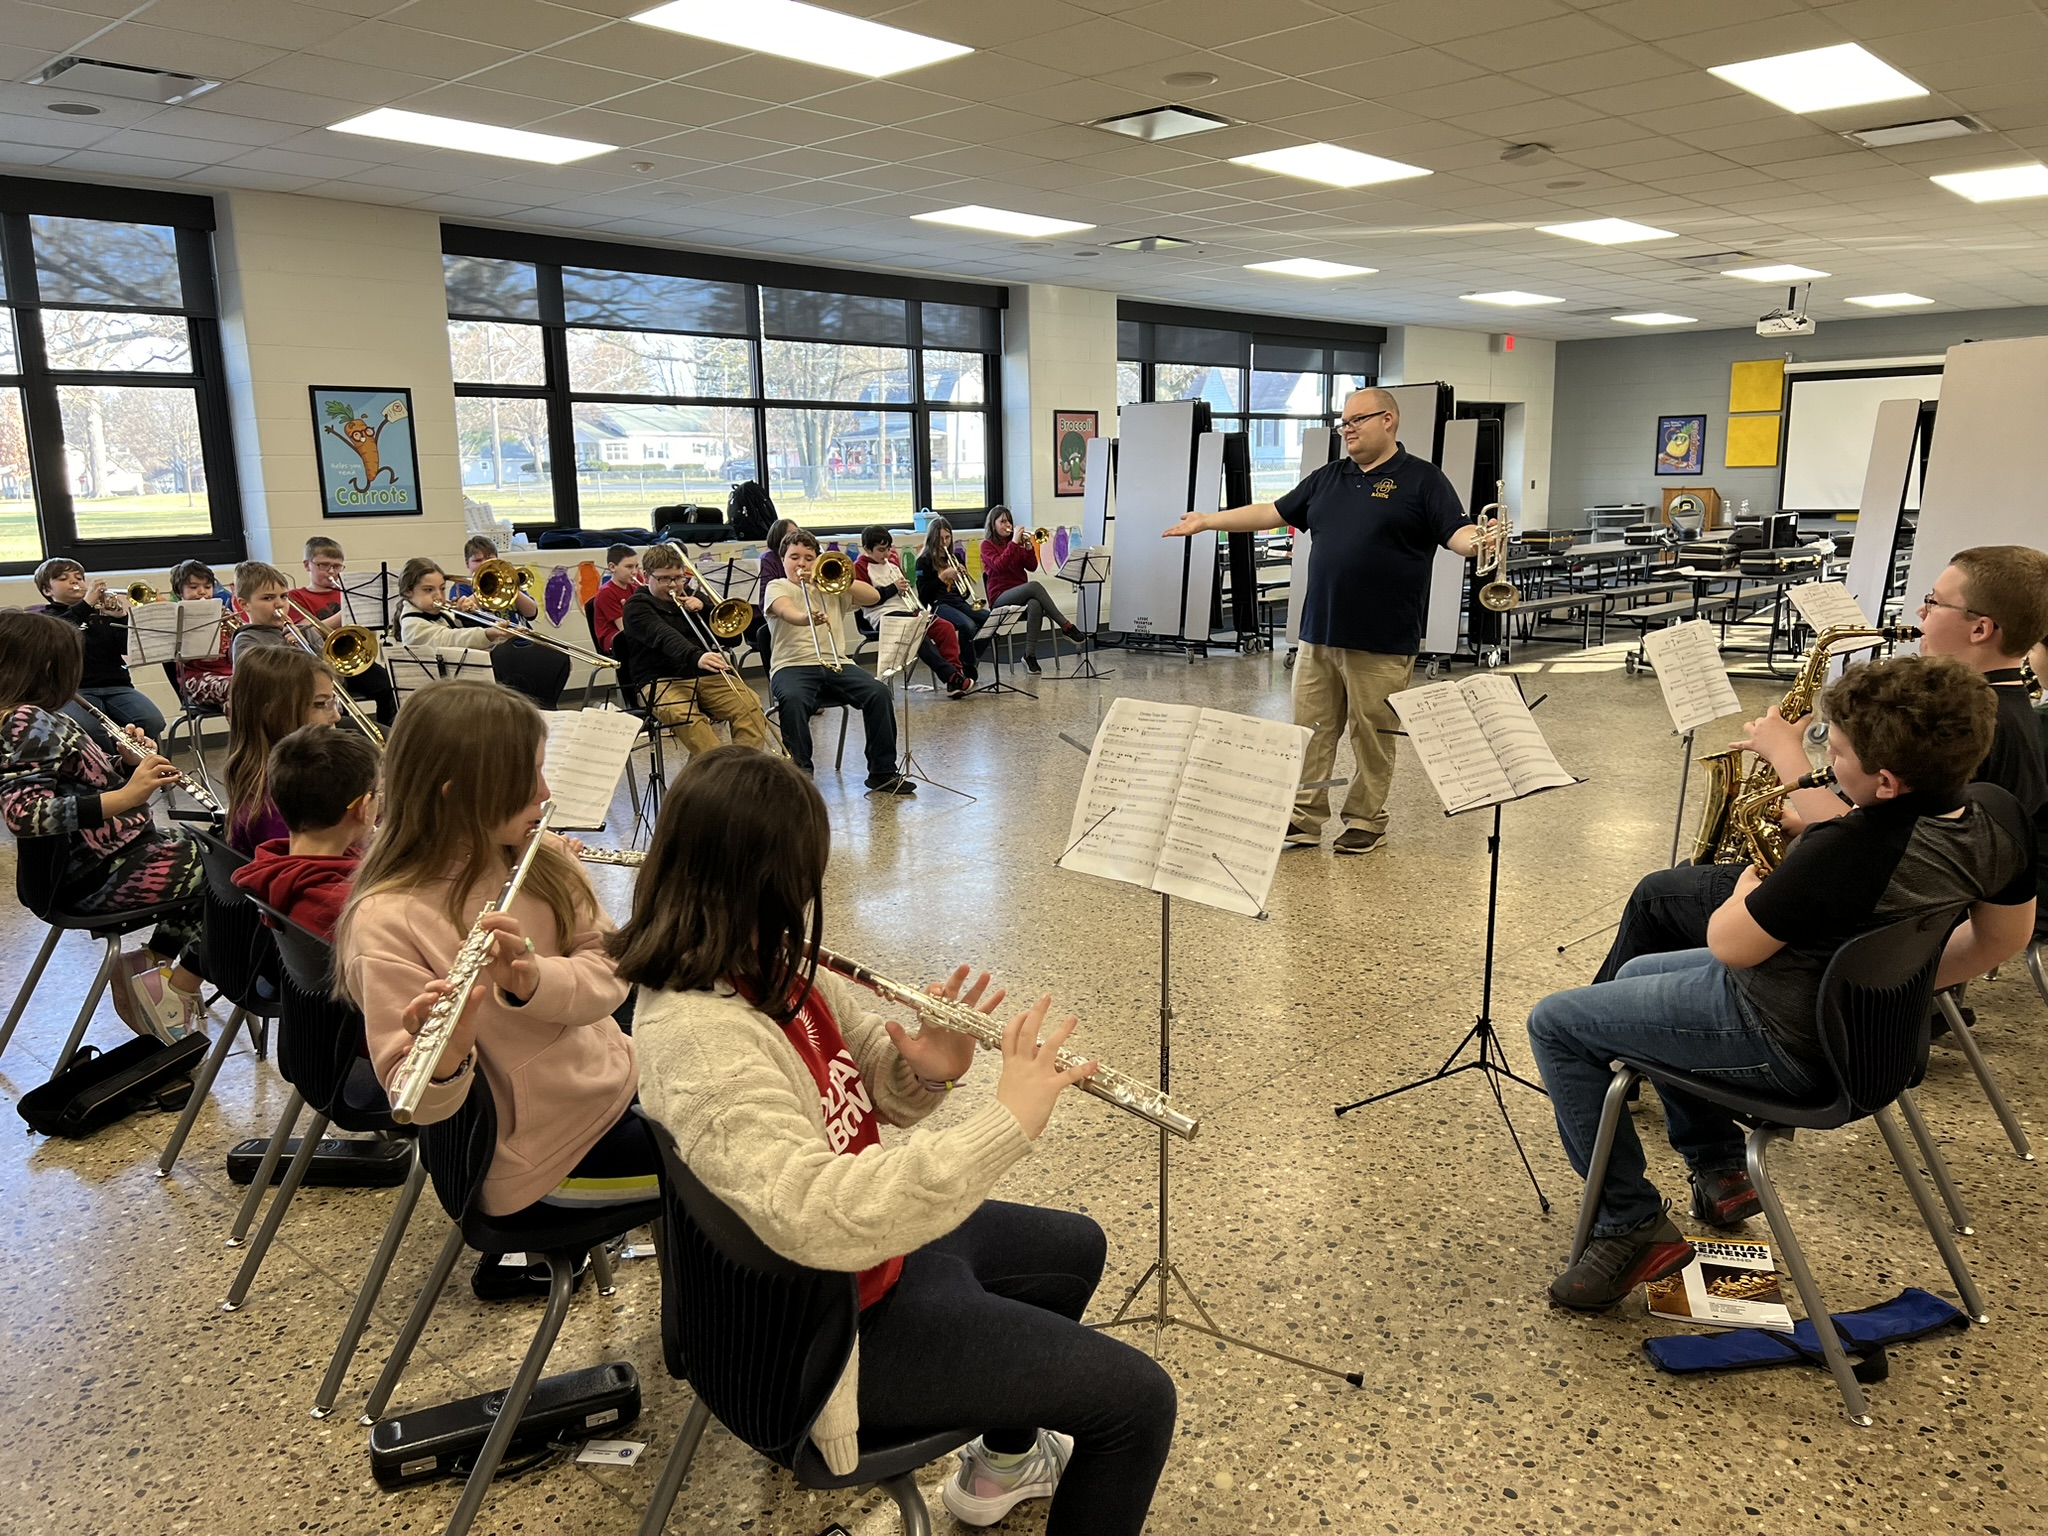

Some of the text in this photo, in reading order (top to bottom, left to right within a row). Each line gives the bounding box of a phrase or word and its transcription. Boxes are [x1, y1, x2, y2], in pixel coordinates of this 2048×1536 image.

[1060, 418, 1092, 431] Broccoli
[335, 486, 408, 506] Carrots
[1687, 1240, 1768, 1253] SSENTIAL
[1698, 1247, 1768, 1260] EMENTS
